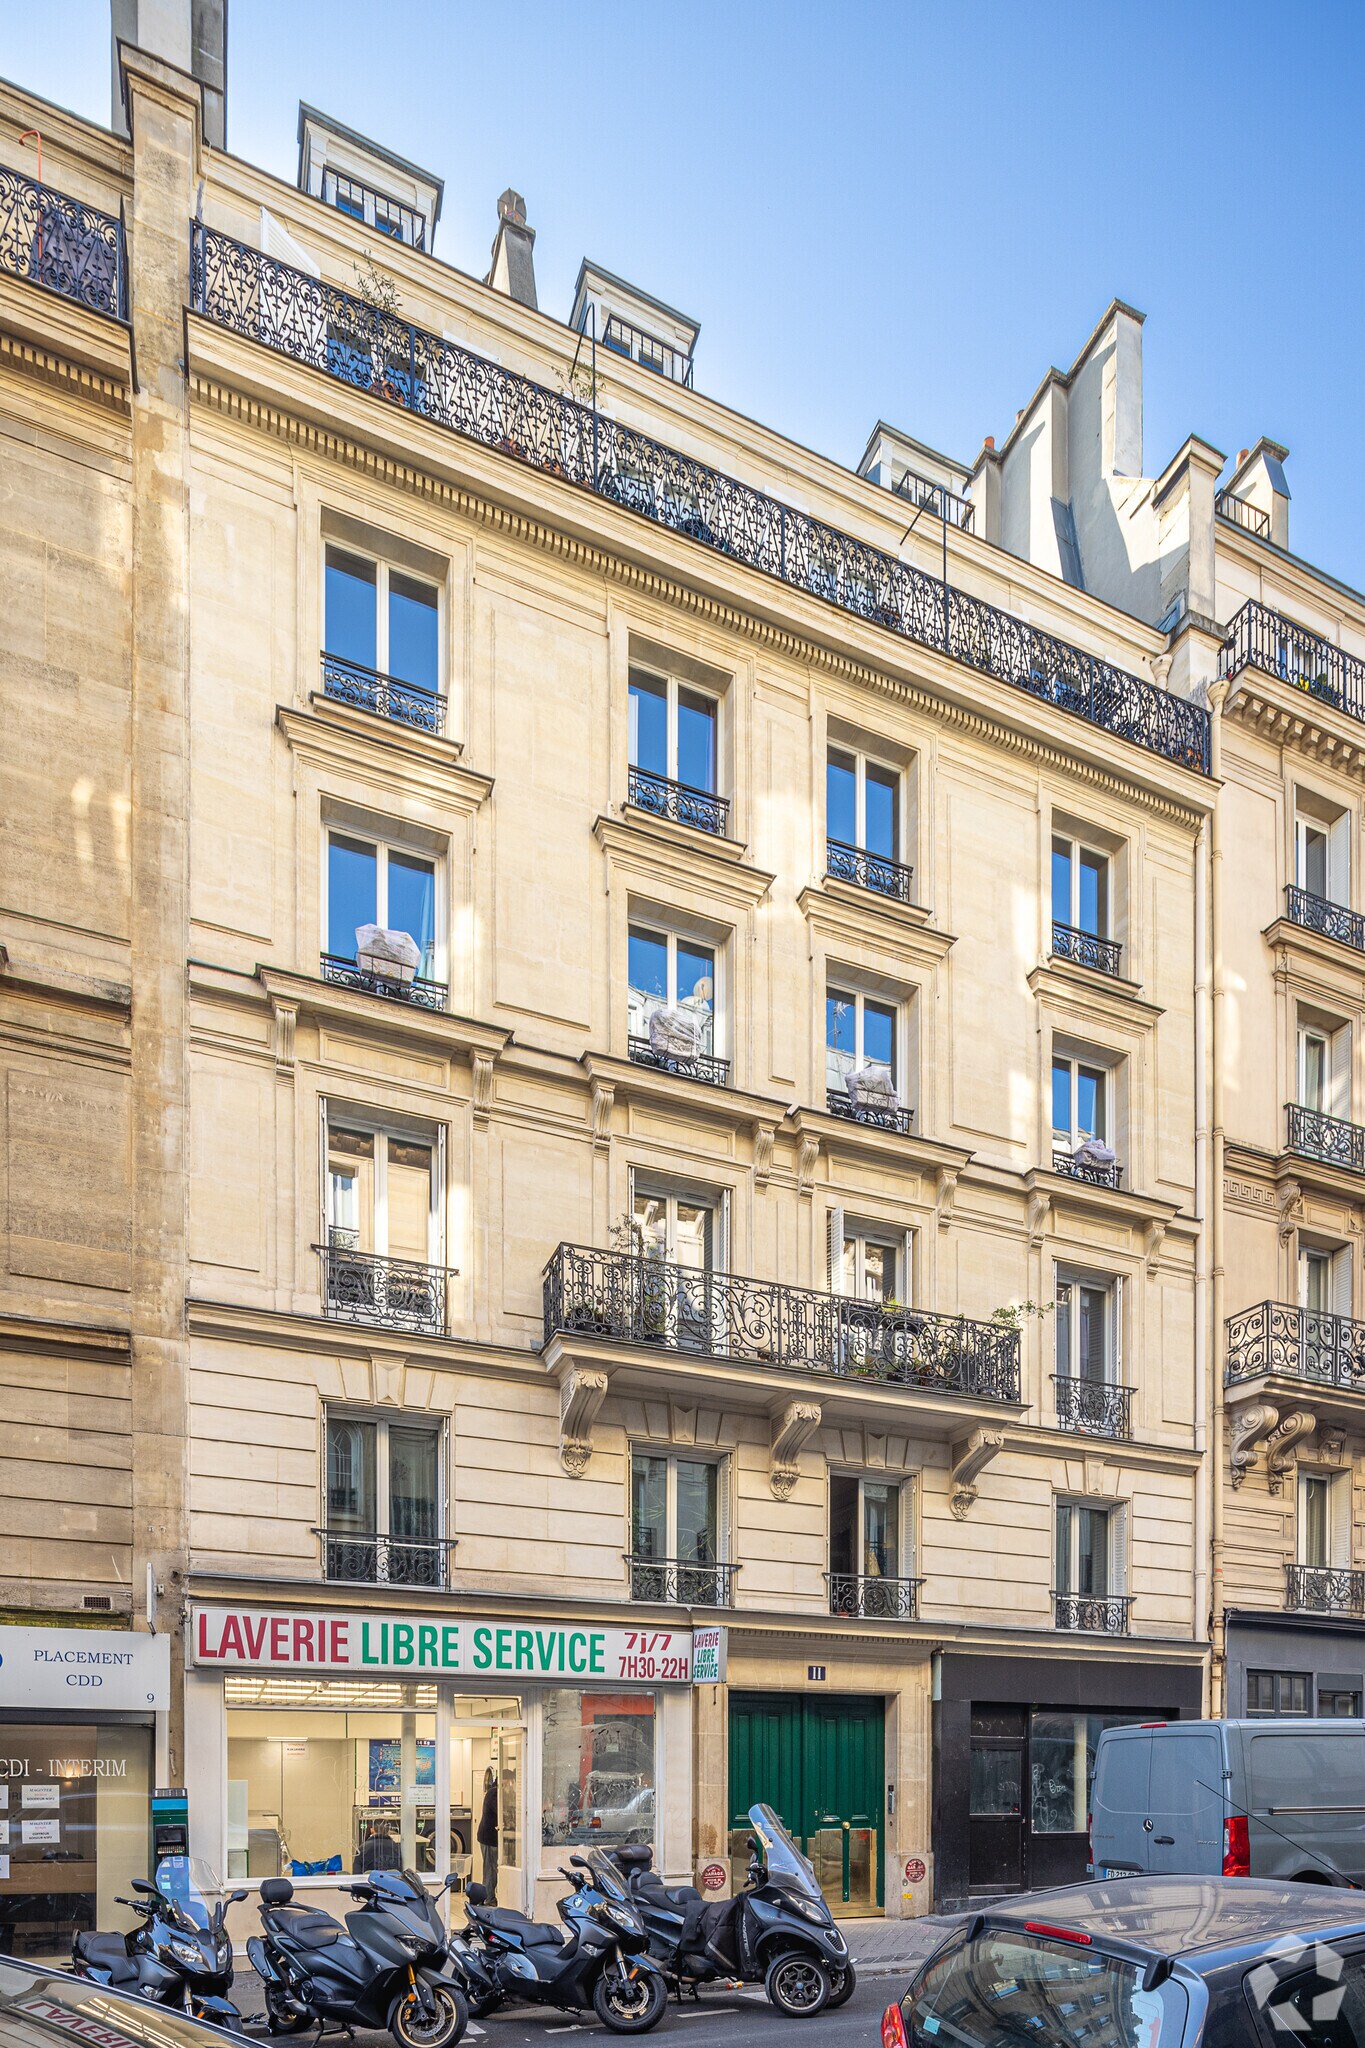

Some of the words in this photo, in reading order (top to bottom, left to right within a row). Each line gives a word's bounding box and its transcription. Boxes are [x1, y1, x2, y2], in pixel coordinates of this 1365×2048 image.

[198, 1613, 350, 1664] LAVERIE
[361, 1621, 460, 1668] LIBRE
[472, 1627, 606, 1674] SERVICE
[624, 1632, 672, 1654] 7j/7
[694, 1632, 720, 1649] LAVERIE
[33, 1649, 134, 1665] PLACEMENT
[697, 1648, 716, 1663] LIBRE
[618, 1656, 689, 1680] 7H30-22H
[692, 1663, 719, 1680] SERVICE
[65, 1674, 103, 1687] CDD
[146, 1692, 155, 1703] 9
[0, 1758, 30, 1777] CDI
[48, 1758, 127, 1777] INTERIM
